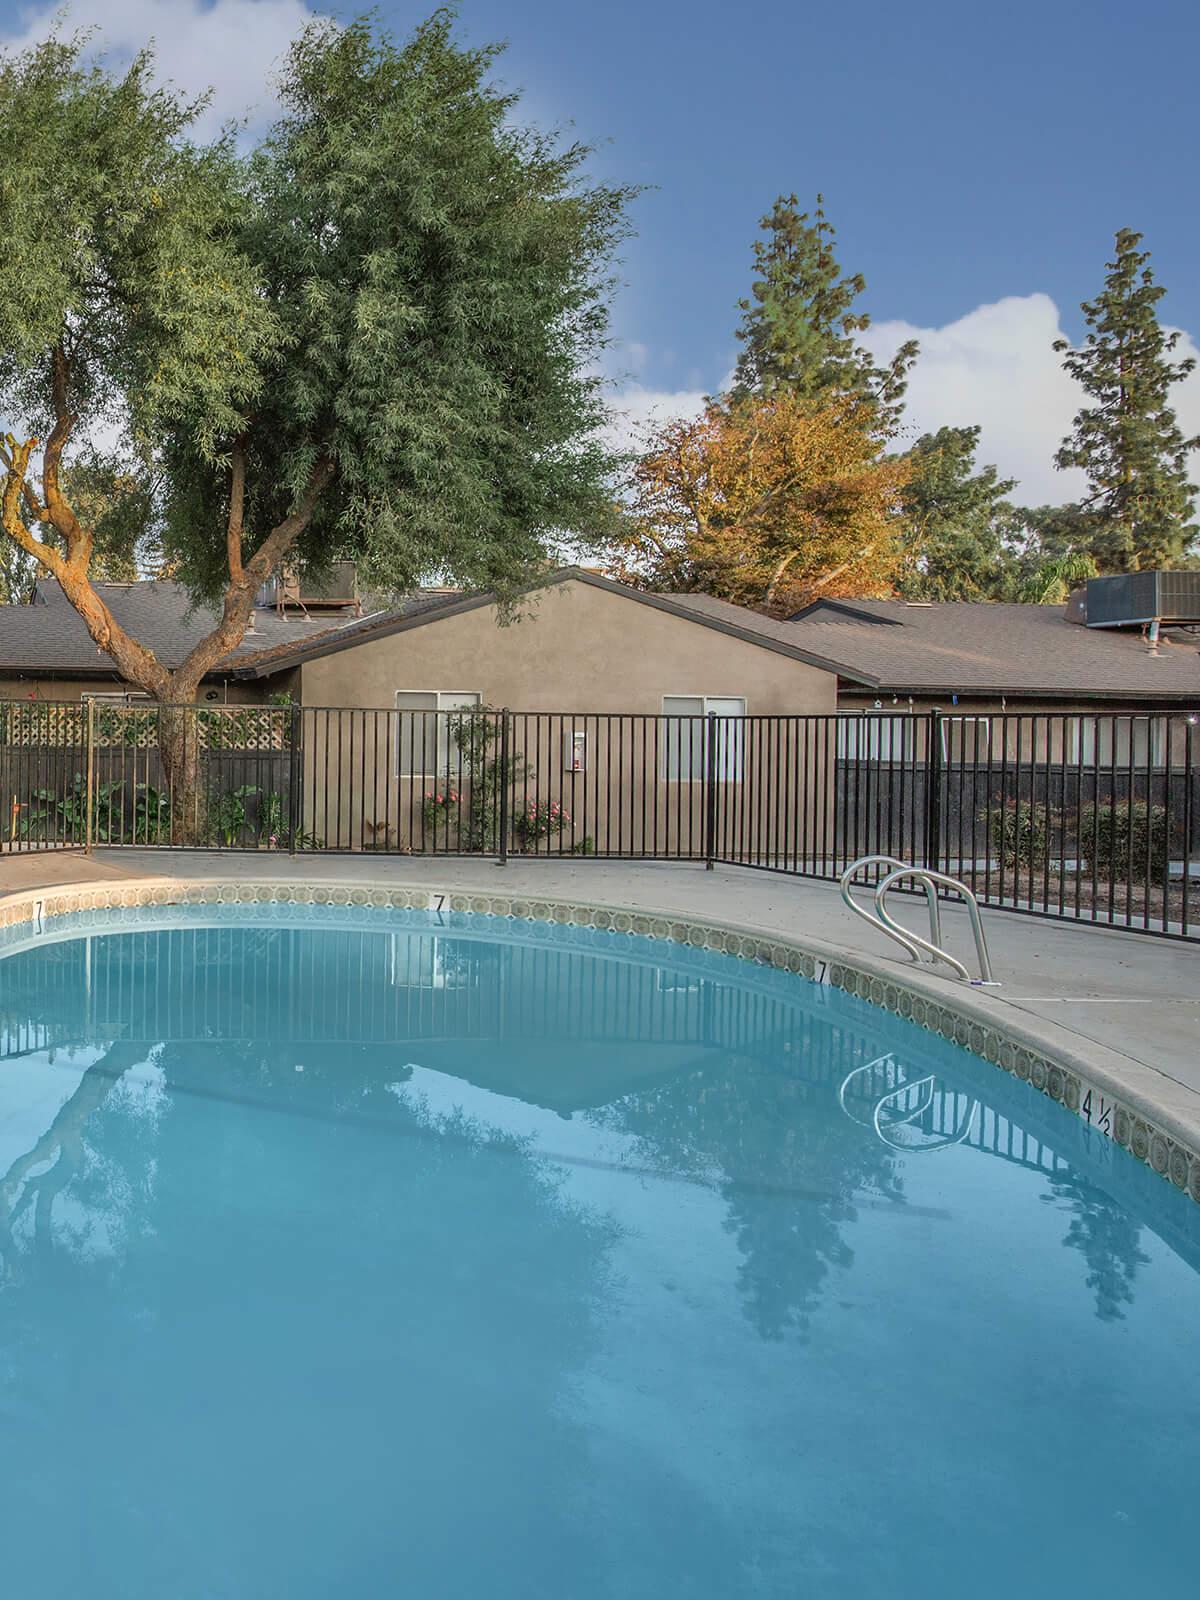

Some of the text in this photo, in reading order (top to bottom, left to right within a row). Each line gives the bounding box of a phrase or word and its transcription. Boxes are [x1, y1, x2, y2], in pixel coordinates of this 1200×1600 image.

[35, 901, 42, 919] 7
[433, 894, 445, 911] 7
[818, 960, 826, 984] 7
[1082, 1090, 1091, 1123] 4
